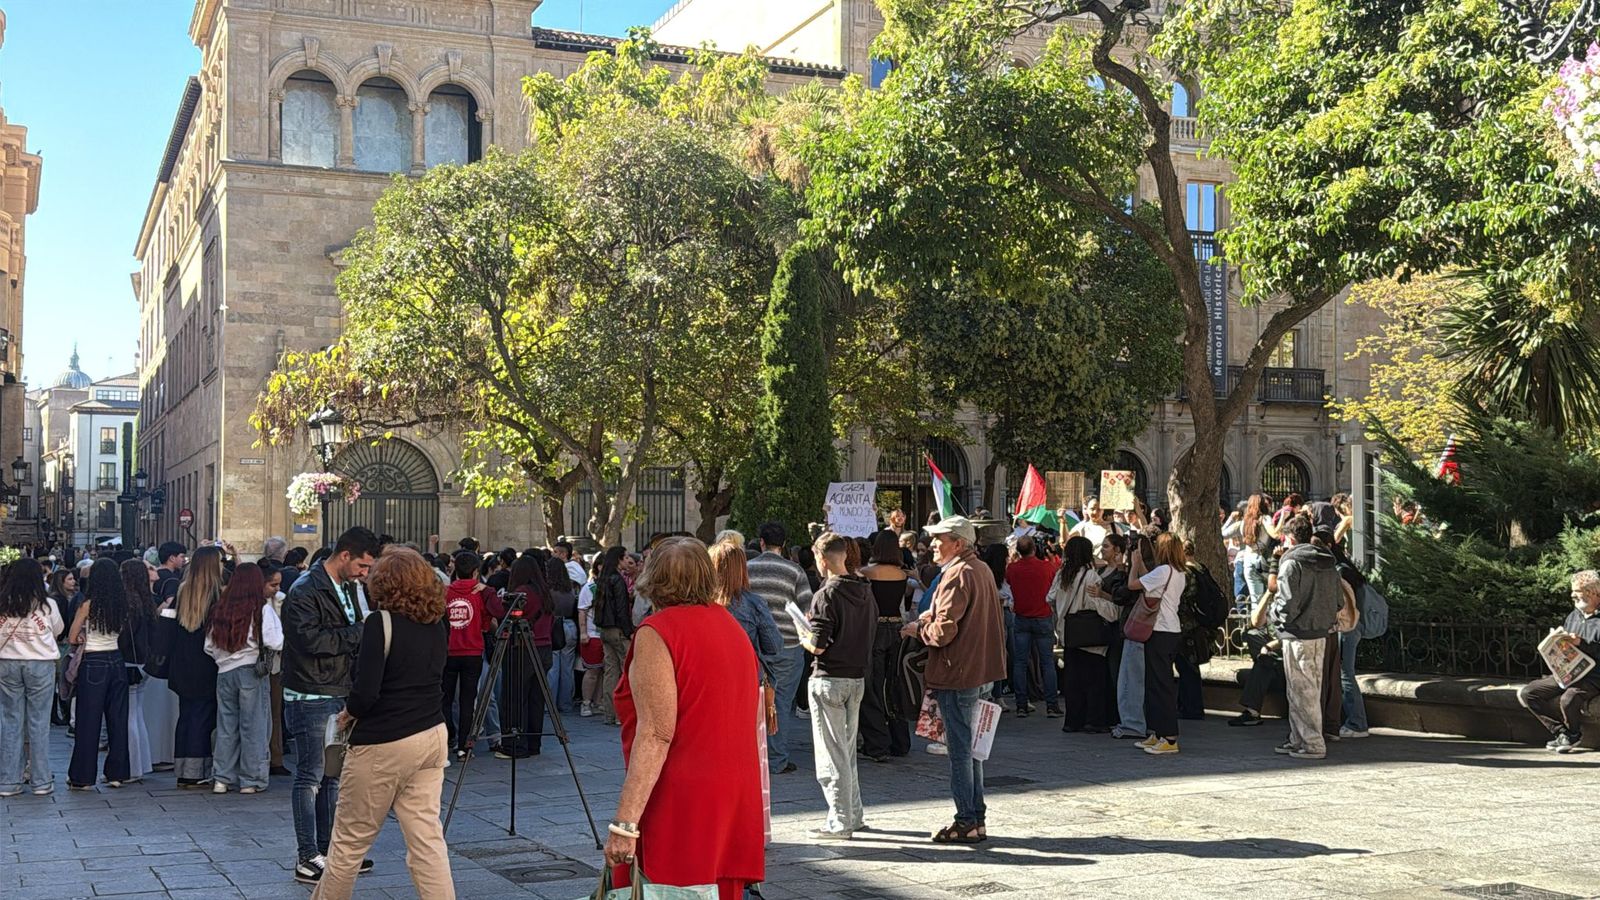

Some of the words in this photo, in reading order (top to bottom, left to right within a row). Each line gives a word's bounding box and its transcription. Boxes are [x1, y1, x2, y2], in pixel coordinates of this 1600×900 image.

[1204, 275, 1211, 287] de
[1213, 266, 1222, 319] Histórica
[1214, 324, 1222, 376] Memoria
[841, 483, 865, 492] GAZA
[829, 493, 870, 505] AGUANTA
